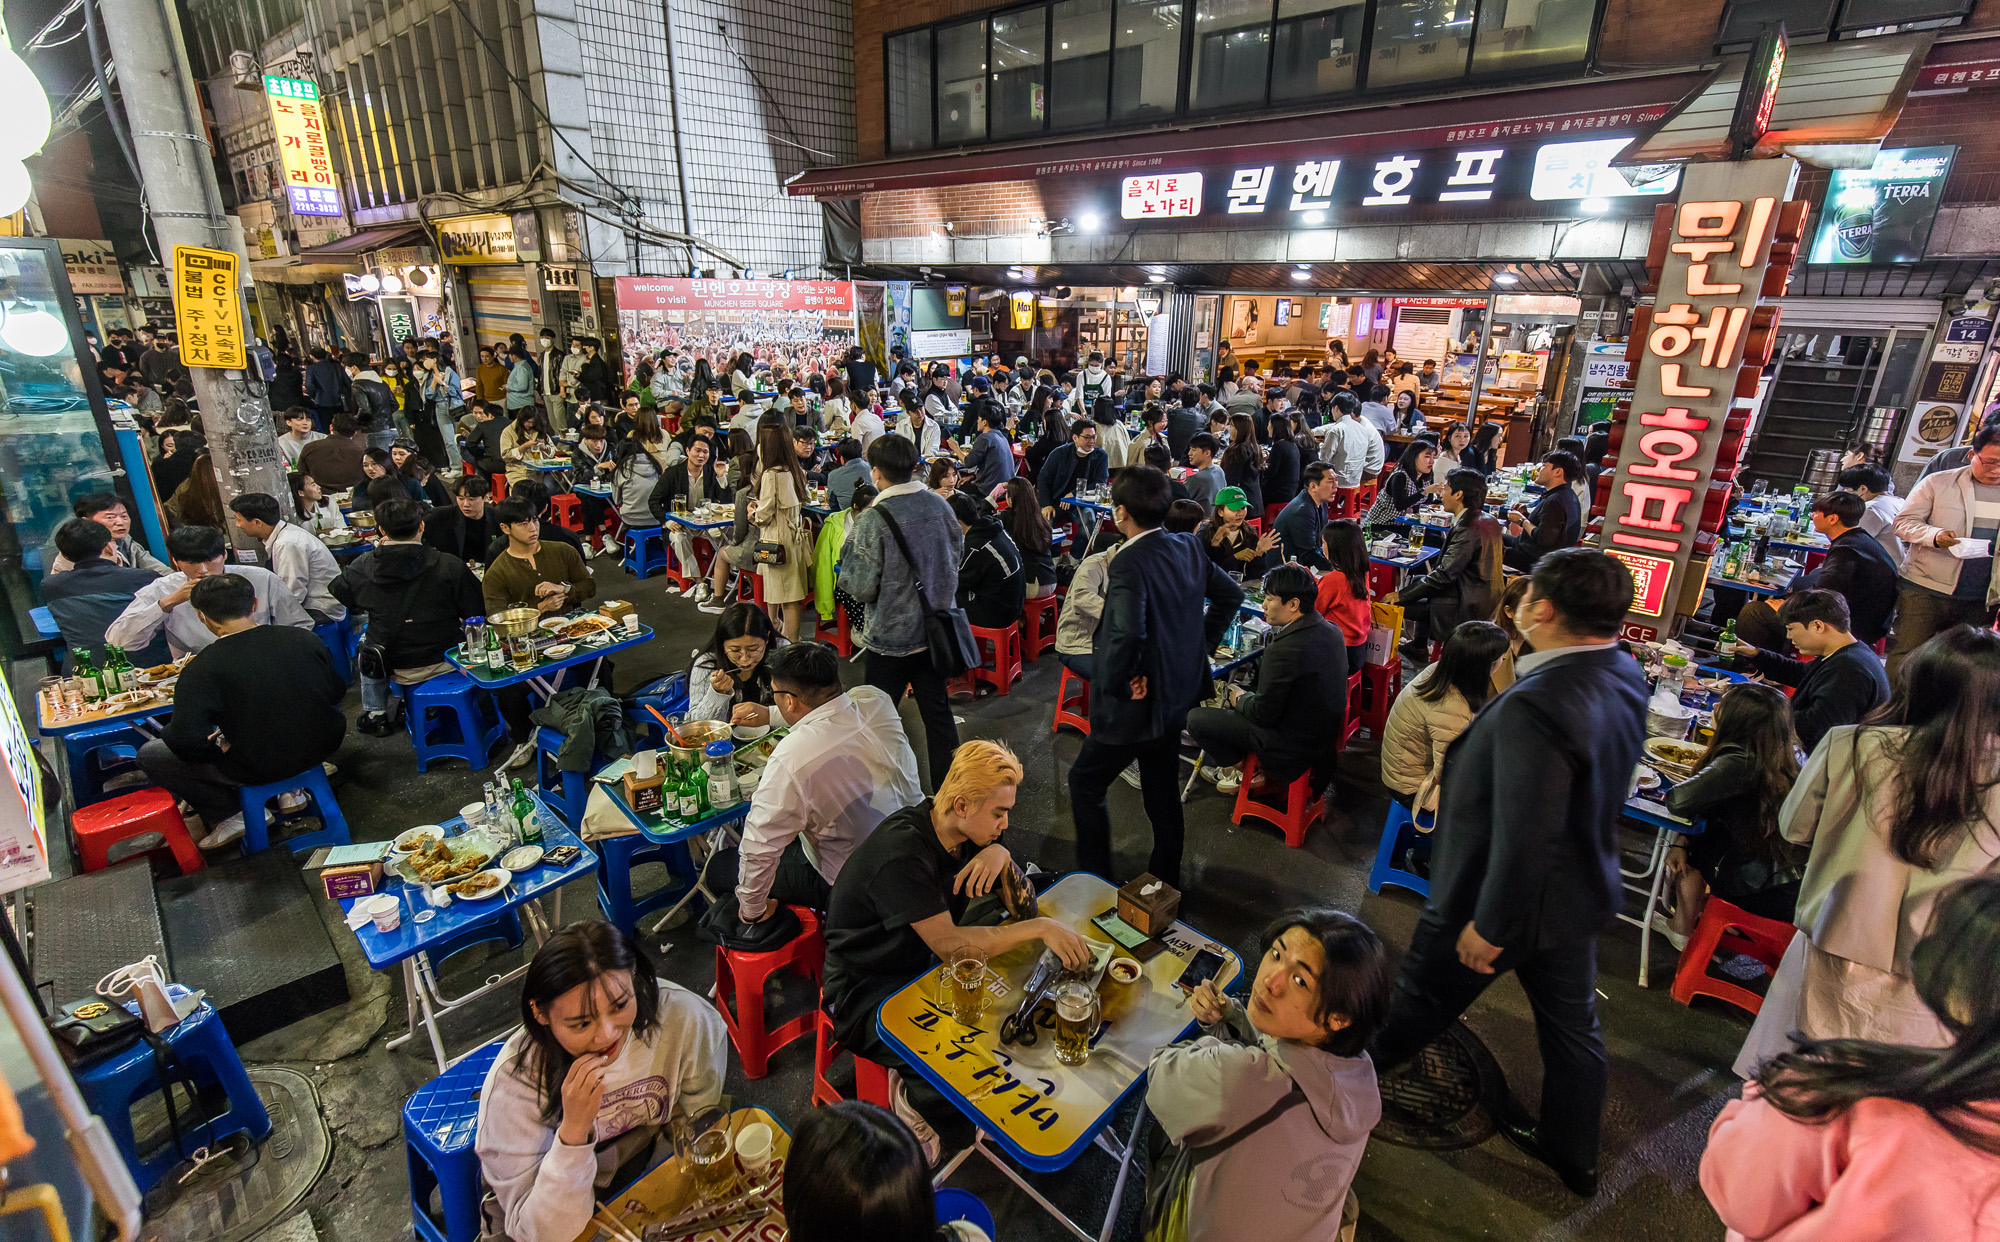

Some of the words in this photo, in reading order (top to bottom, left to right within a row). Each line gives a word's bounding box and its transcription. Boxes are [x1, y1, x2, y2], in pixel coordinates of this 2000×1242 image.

[1379, 48, 1397, 60] 3M
[1418, 43, 1436, 55] 3M
[1335, 57, 1350, 68] 3M
[1446, 126, 1487, 142] 뮌헨호프
[1490, 121, 1556, 138] 을지로노가리
[1561, 113, 1632, 132] 을지로골뱅이
[276, 100, 309, 183] 노가리
[300, 103, 331, 185] 을지로골뱅이
[1058, 163, 1092, 174] 을지로노가리
[1094, 159, 1130, 171] 을지로골뱅이
[1132, 158, 1147, 167] Since
[1128, 178, 1179, 198] 을지로
[1227, 149, 1504, 214] 뮌헨호프
[1883, 181, 1931, 199] TERRA
[1142, 198, 1194, 215] 노가리
[1840, 224, 1873, 239] TERRA
[62, 250, 103, 264] aki
[184, 270, 203, 299] 불법
[633, 283, 675, 293] welcome
[690, 280, 793, 299] 뮌헨호프광장
[817, 286, 837, 295] 노가리
[212, 274, 229, 320] CCTV
[656, 296, 666, 304] to
[667, 295, 687, 304] visit
[739, 299, 757, 308] BEER
[758, 299, 784, 308] SQUARE
[804, 296, 824, 305] 골뱅이
[1458, 298, 1488, 306] 사용합니
[1016, 301, 1032, 313] Max
[1960, 329, 1977, 339] 14
[214, 325, 237, 363] 단속중
[1590, 363, 1630, 376] 냉수전용
[1612, 197, 1776, 552] 뮌헨호프
[1604, 378, 1621, 387] (Se
[1922, 417, 1953, 429] Max
[1618, 624, 1653, 642] NCE
[1166, 936, 1196, 952] NEW
[961, 980, 982, 990] TERRA
[615, 1082, 664, 1098] MERCREDI
